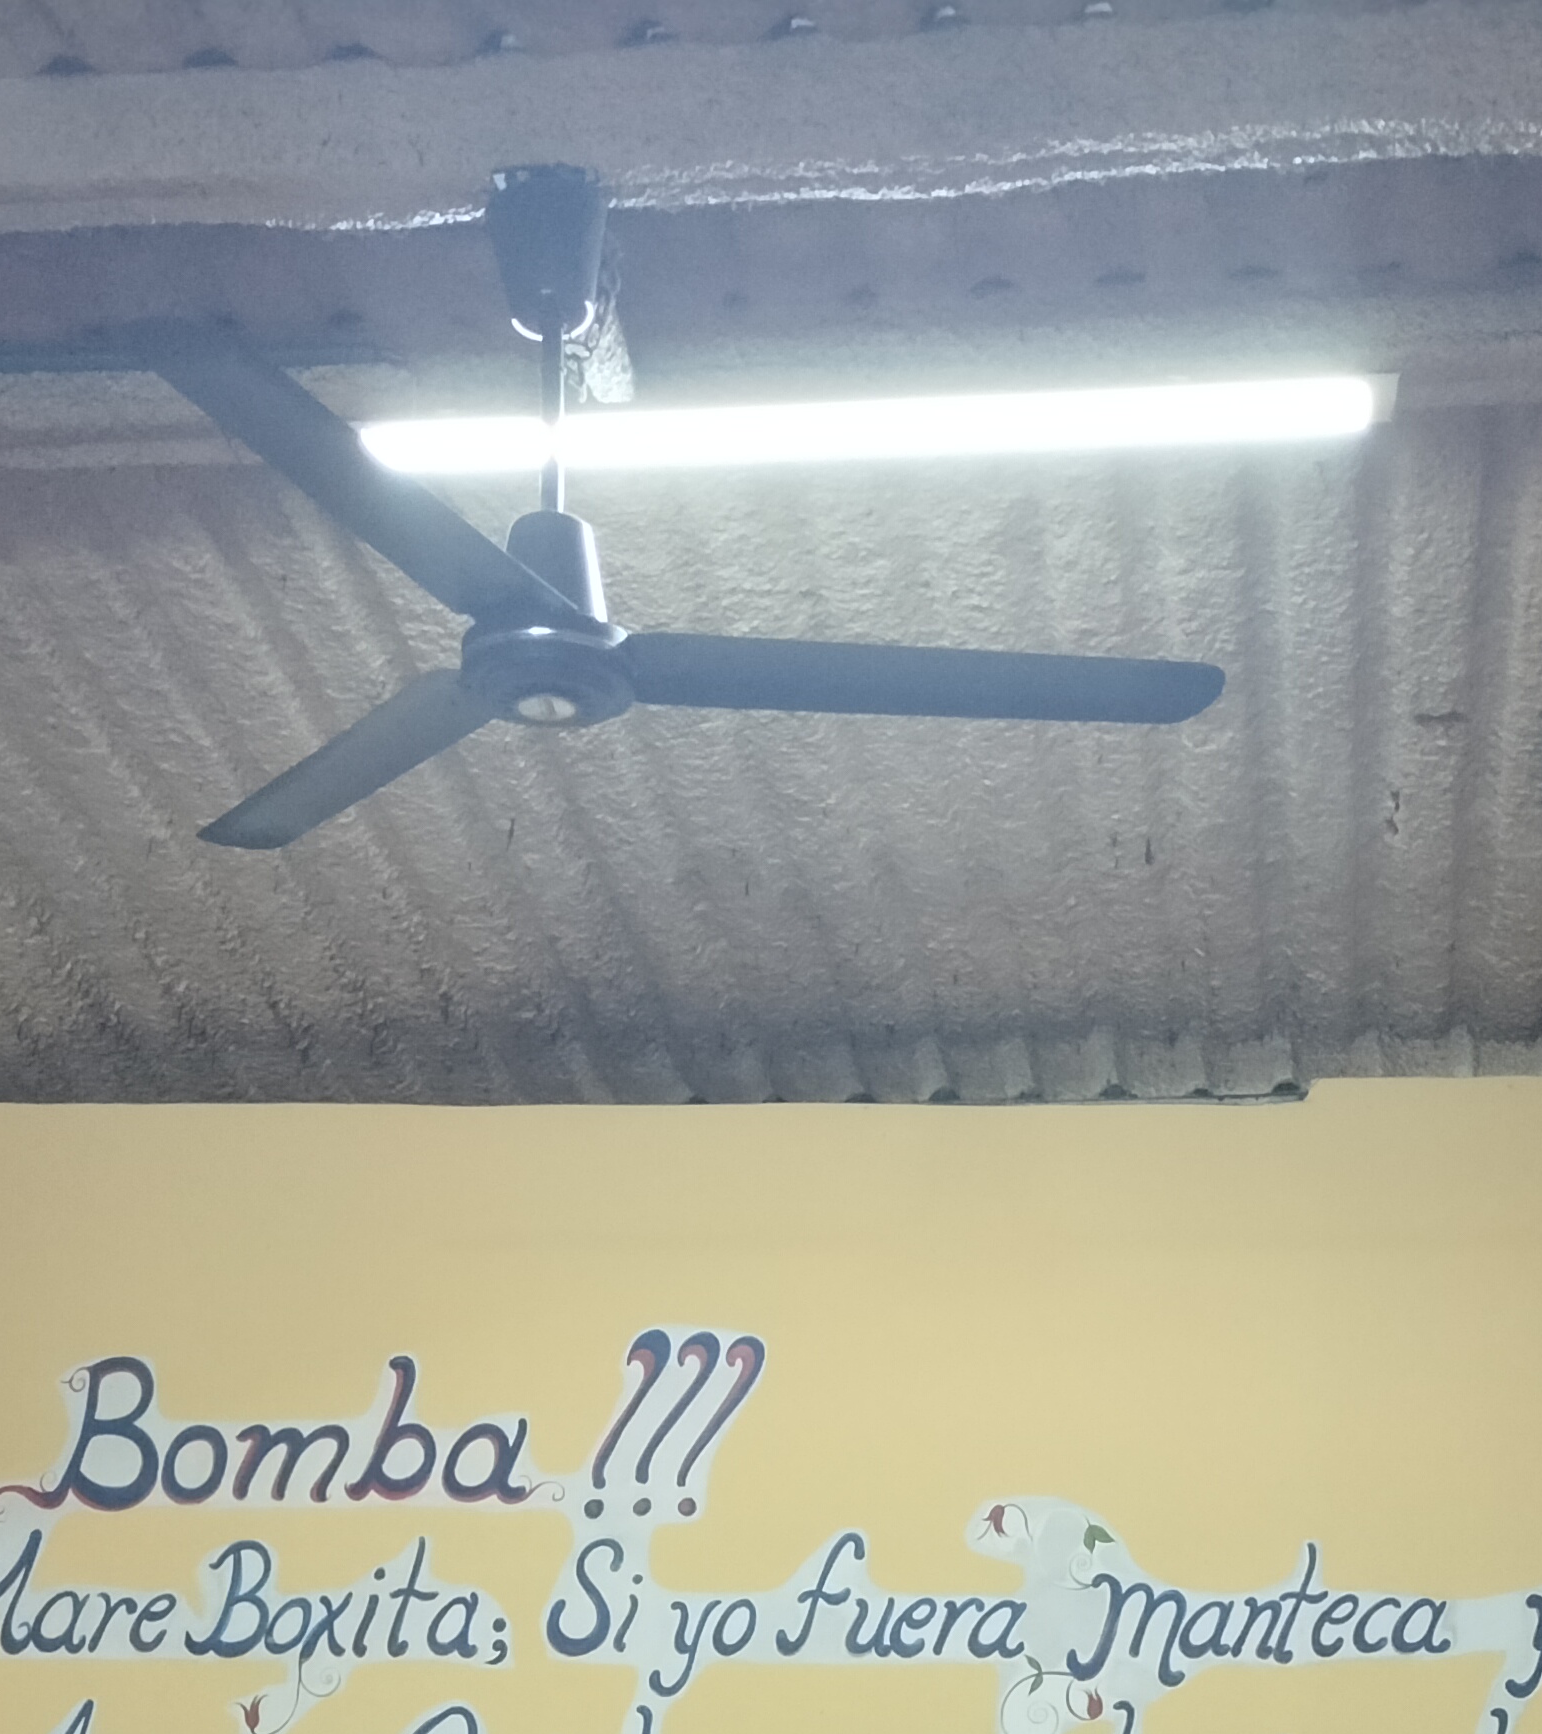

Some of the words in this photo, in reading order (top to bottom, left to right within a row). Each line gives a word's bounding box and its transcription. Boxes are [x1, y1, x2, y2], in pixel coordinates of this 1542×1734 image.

[54, 1354, 531, 1508] Bomba
[546, 1536, 645, 1657] Si
[647, 1592, 758, 1699] yo
[775, 1531, 1027, 1662] fuera
